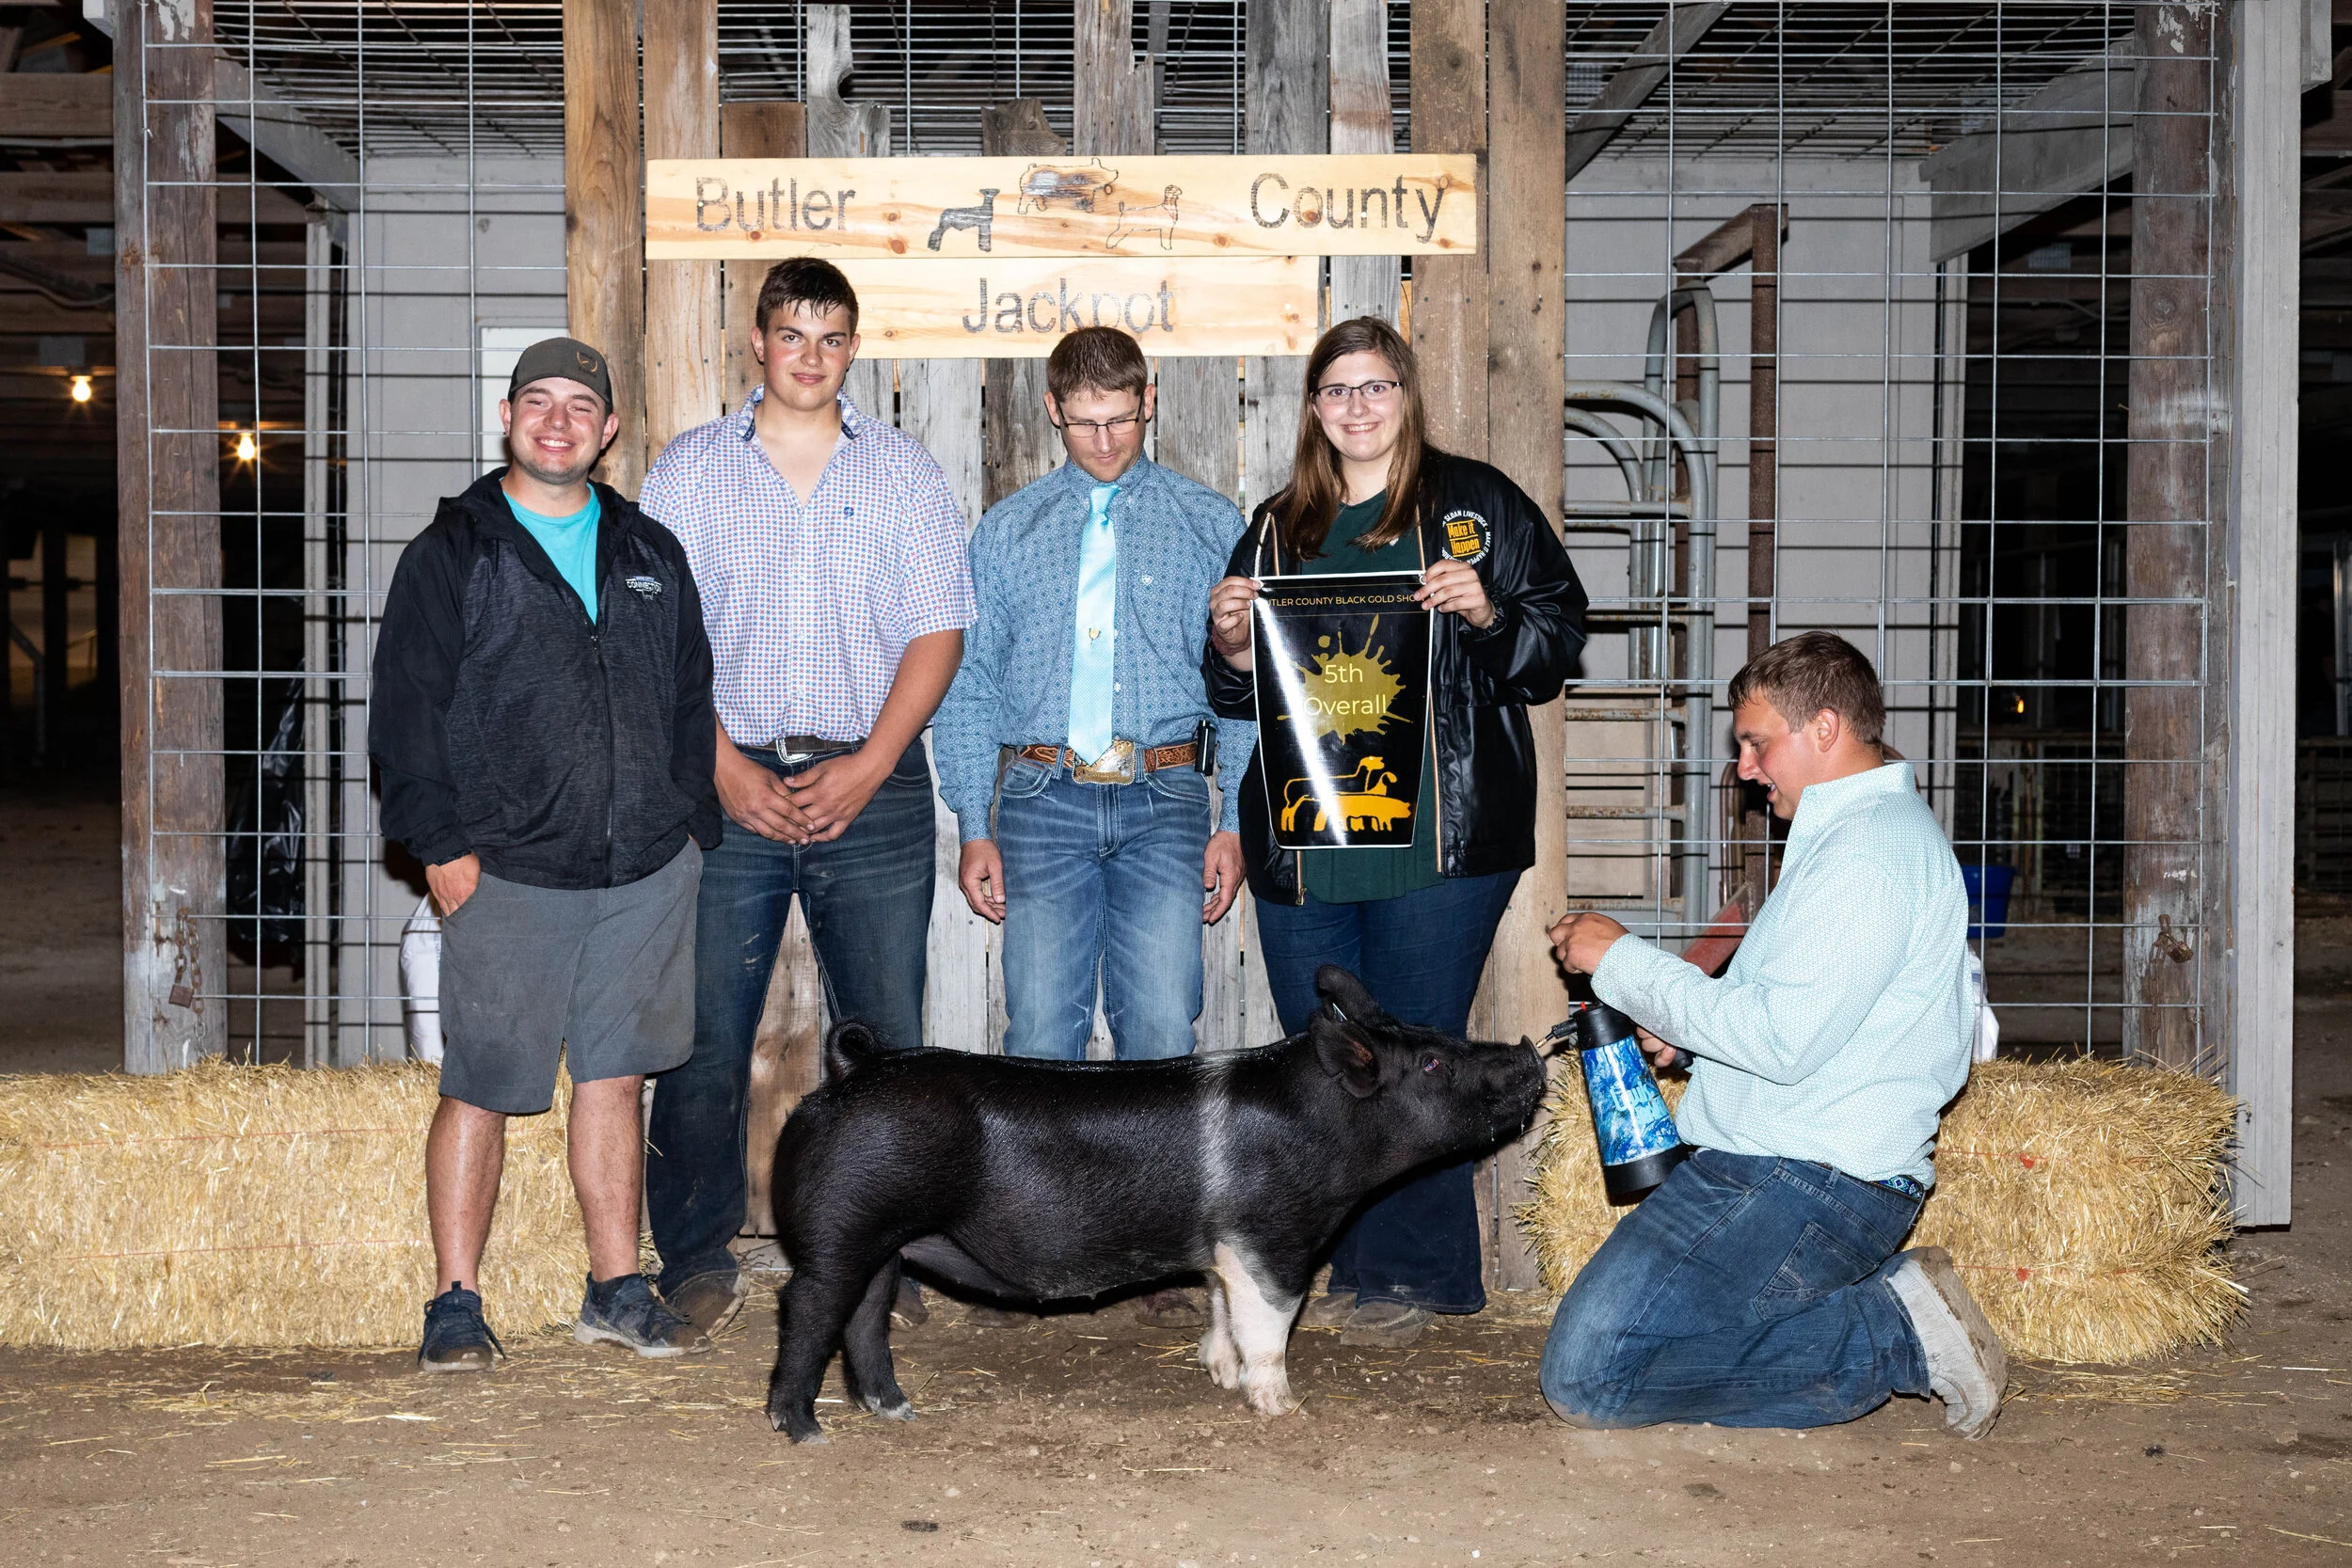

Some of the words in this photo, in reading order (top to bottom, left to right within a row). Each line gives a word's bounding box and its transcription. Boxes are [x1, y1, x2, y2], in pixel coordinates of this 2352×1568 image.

[695, 177, 857, 232] Butler
[1250, 172, 1445, 244] County
[961, 277, 1175, 334] Jackpot
[1462, 510, 1488, 528] LIVESTOCK
[1447, 522, 1469, 539] Make
[1450, 538, 1481, 555] Happen
[1266, 597, 1294, 607] TLER
[1295, 596, 1334, 606] COUNTY
[1335, 595, 1366, 605] BLACK
[1367, 594, 1394, 604] GOLD
[1396, 594, 1418, 603] SHO
[1324, 662, 1363, 683] 5th
[1304, 694, 1387, 715] Overall
